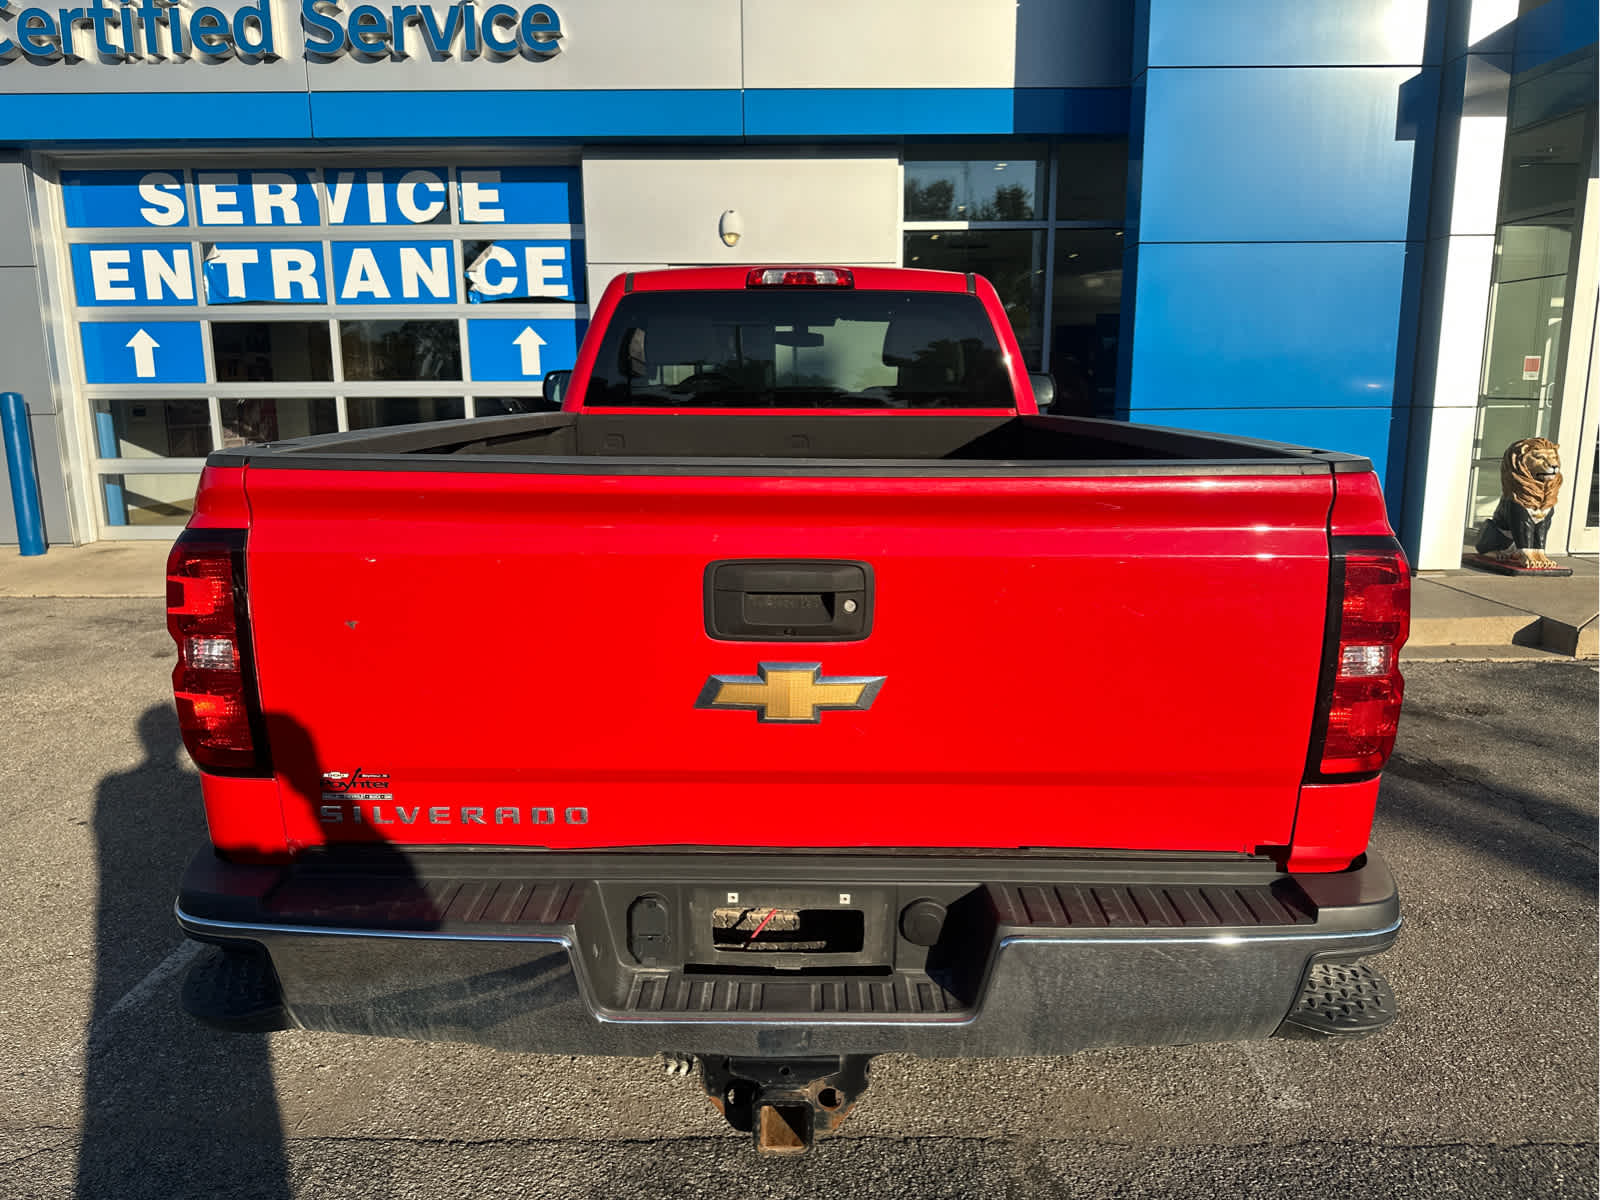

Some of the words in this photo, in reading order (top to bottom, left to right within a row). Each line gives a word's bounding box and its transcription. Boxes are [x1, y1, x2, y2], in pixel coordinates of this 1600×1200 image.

[301, 0, 563, 55] Service
[138, 169, 506, 227] SERVICE
[89, 245, 570, 301] ENTRANCE
[320, 805, 590, 825] SILVERADO
